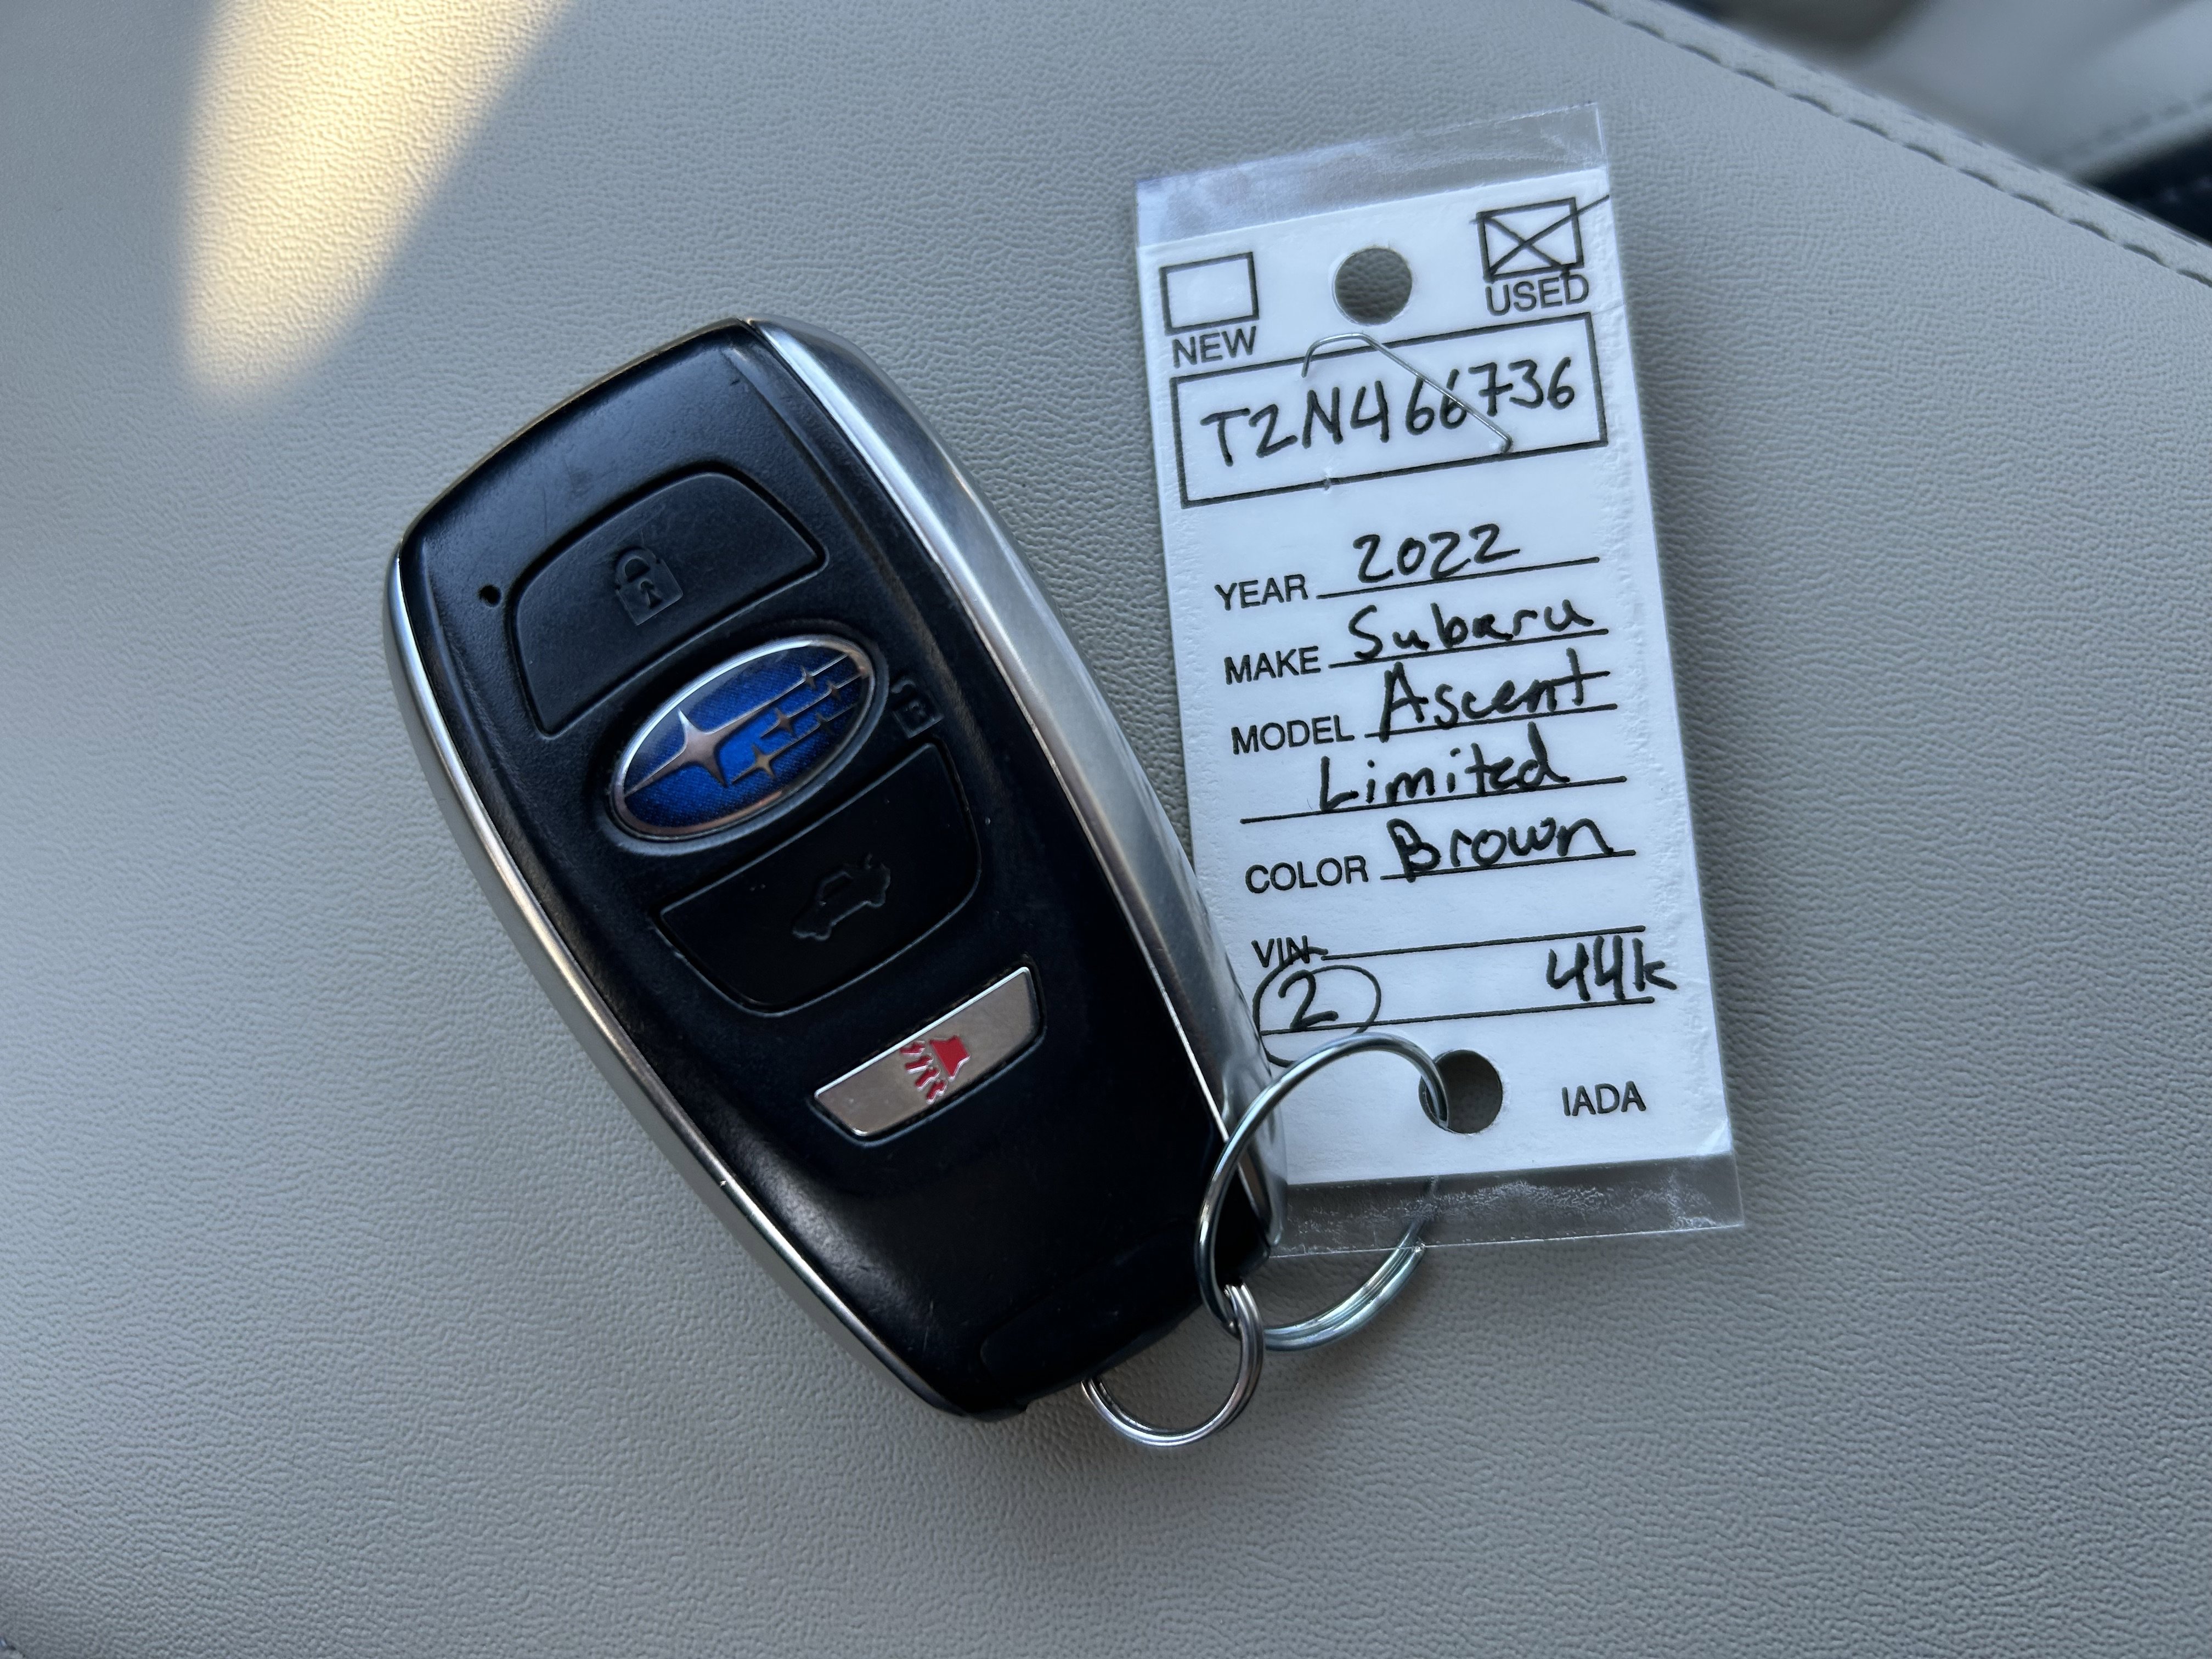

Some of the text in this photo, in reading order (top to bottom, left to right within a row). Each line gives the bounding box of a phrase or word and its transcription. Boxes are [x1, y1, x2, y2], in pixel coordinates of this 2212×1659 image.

[1485, 273, 1590, 316] USED
[1171, 326, 1257, 368] NEW
[1201, 357, 1576, 467] T2N466736
[1214, 523, 1520, 611] YEAR 2022
[1224, 599, 1594, 685] MAKE Subaru
[1231, 648, 1611, 755] MODEL Ascent
[1319, 721, 1570, 812] Limited
[1244, 817, 1615, 895] COLOR Brown
[1251, 935, 1310, 969] VIN
[1278, 968, 1340, 1031] 2
[1562, 1080, 1647, 1117] IADA
